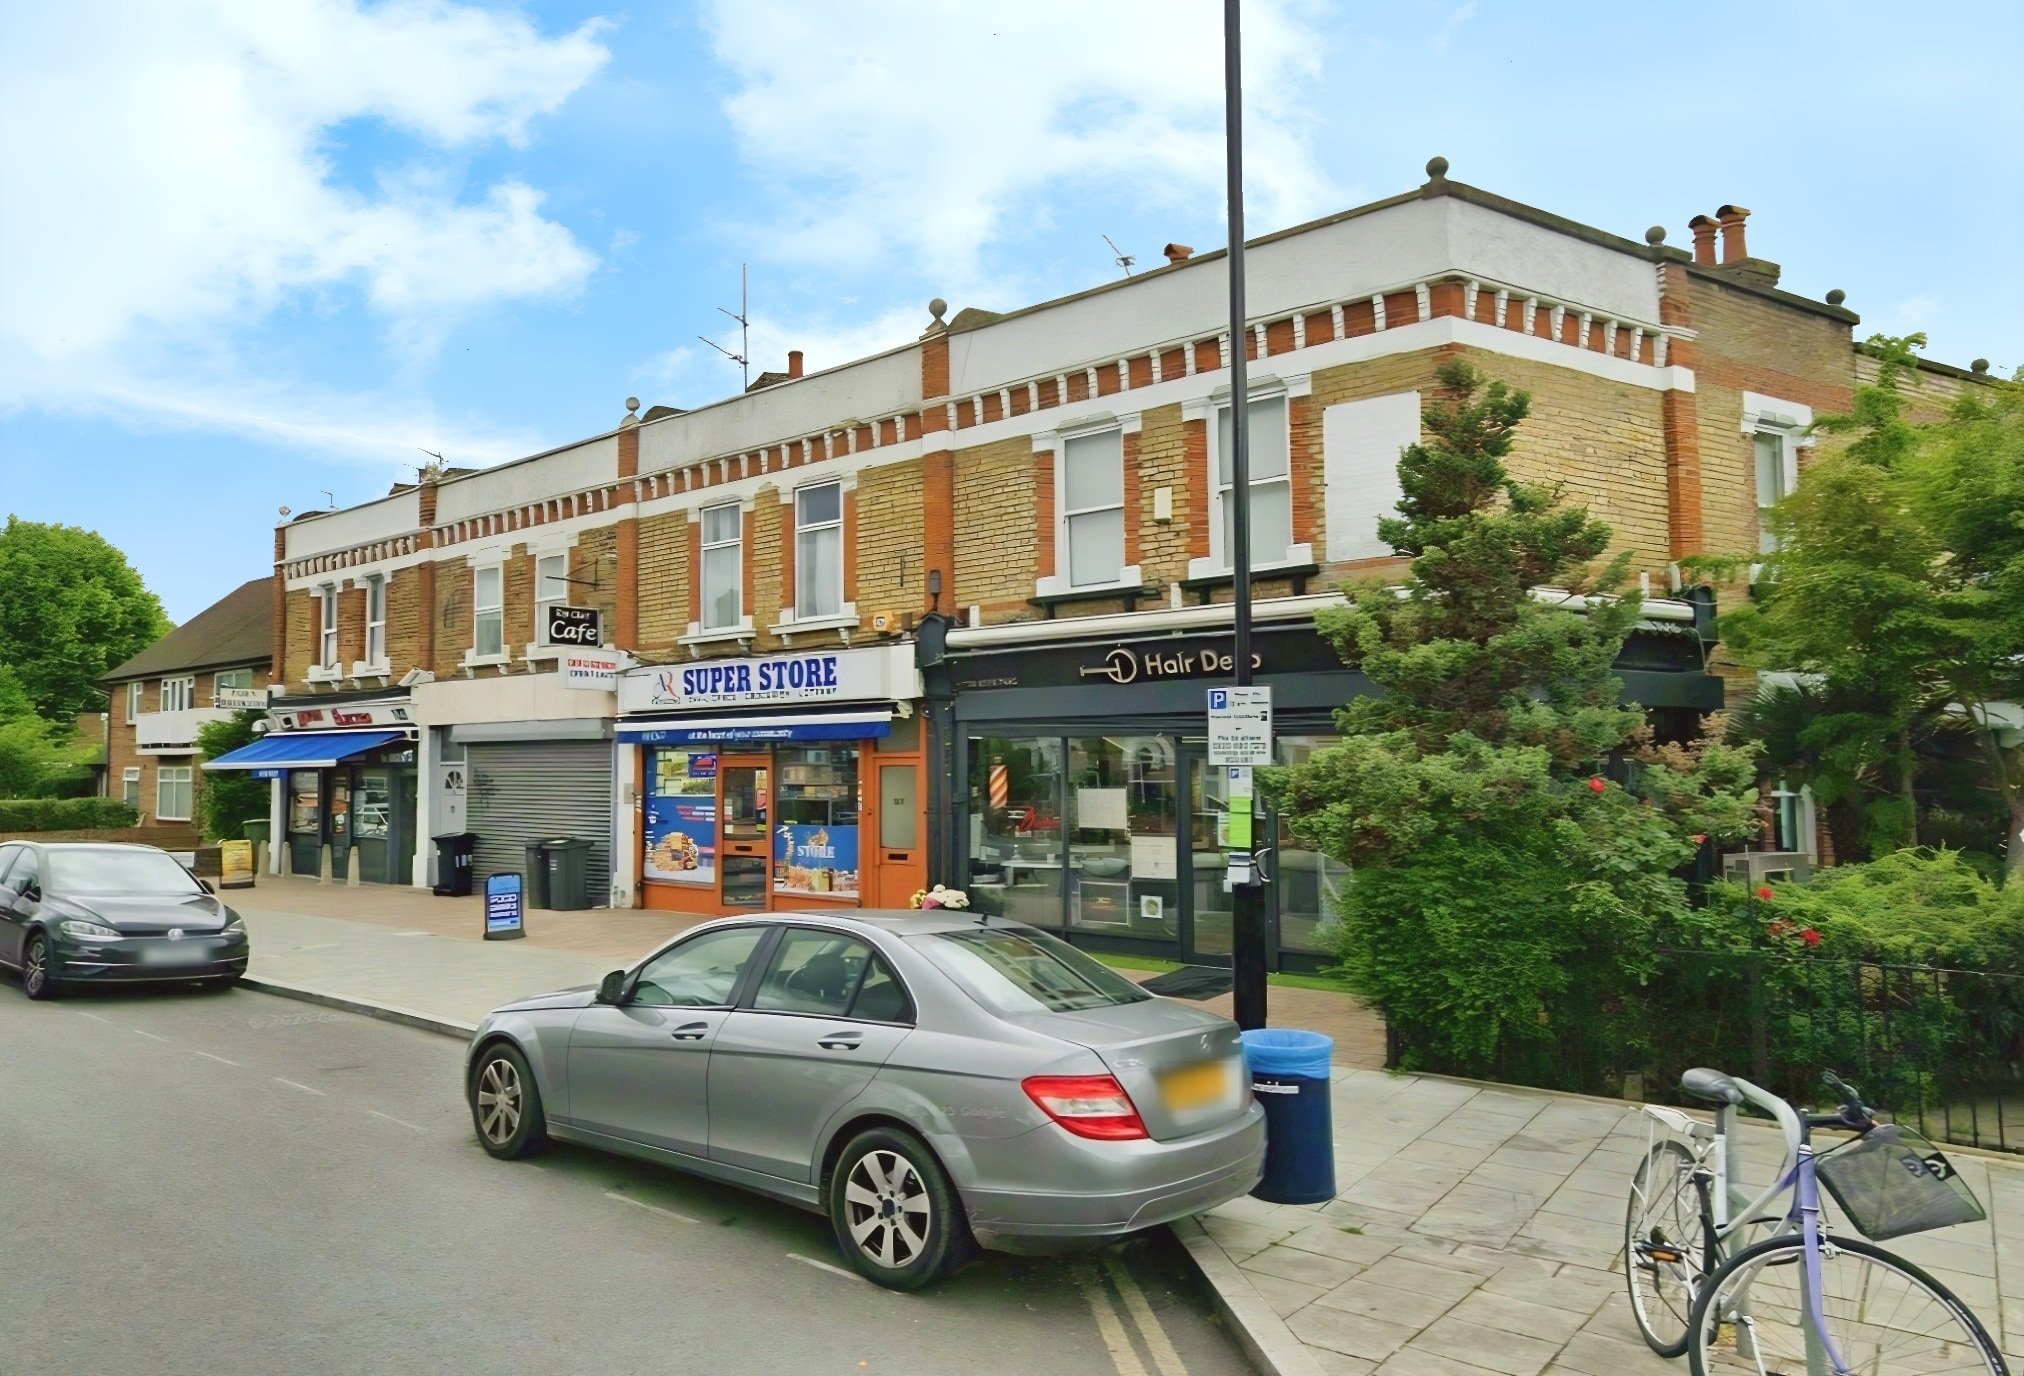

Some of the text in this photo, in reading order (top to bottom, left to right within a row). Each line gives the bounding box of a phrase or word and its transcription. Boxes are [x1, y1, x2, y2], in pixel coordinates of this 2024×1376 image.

[551, 620, 597, 643] Cafe
[1145, 650, 1262, 675] Hair Deo
[683, 664, 752, 696] SUPER
[759, 656, 837, 691] STORE
[1213, 692, 1224, 708] P
